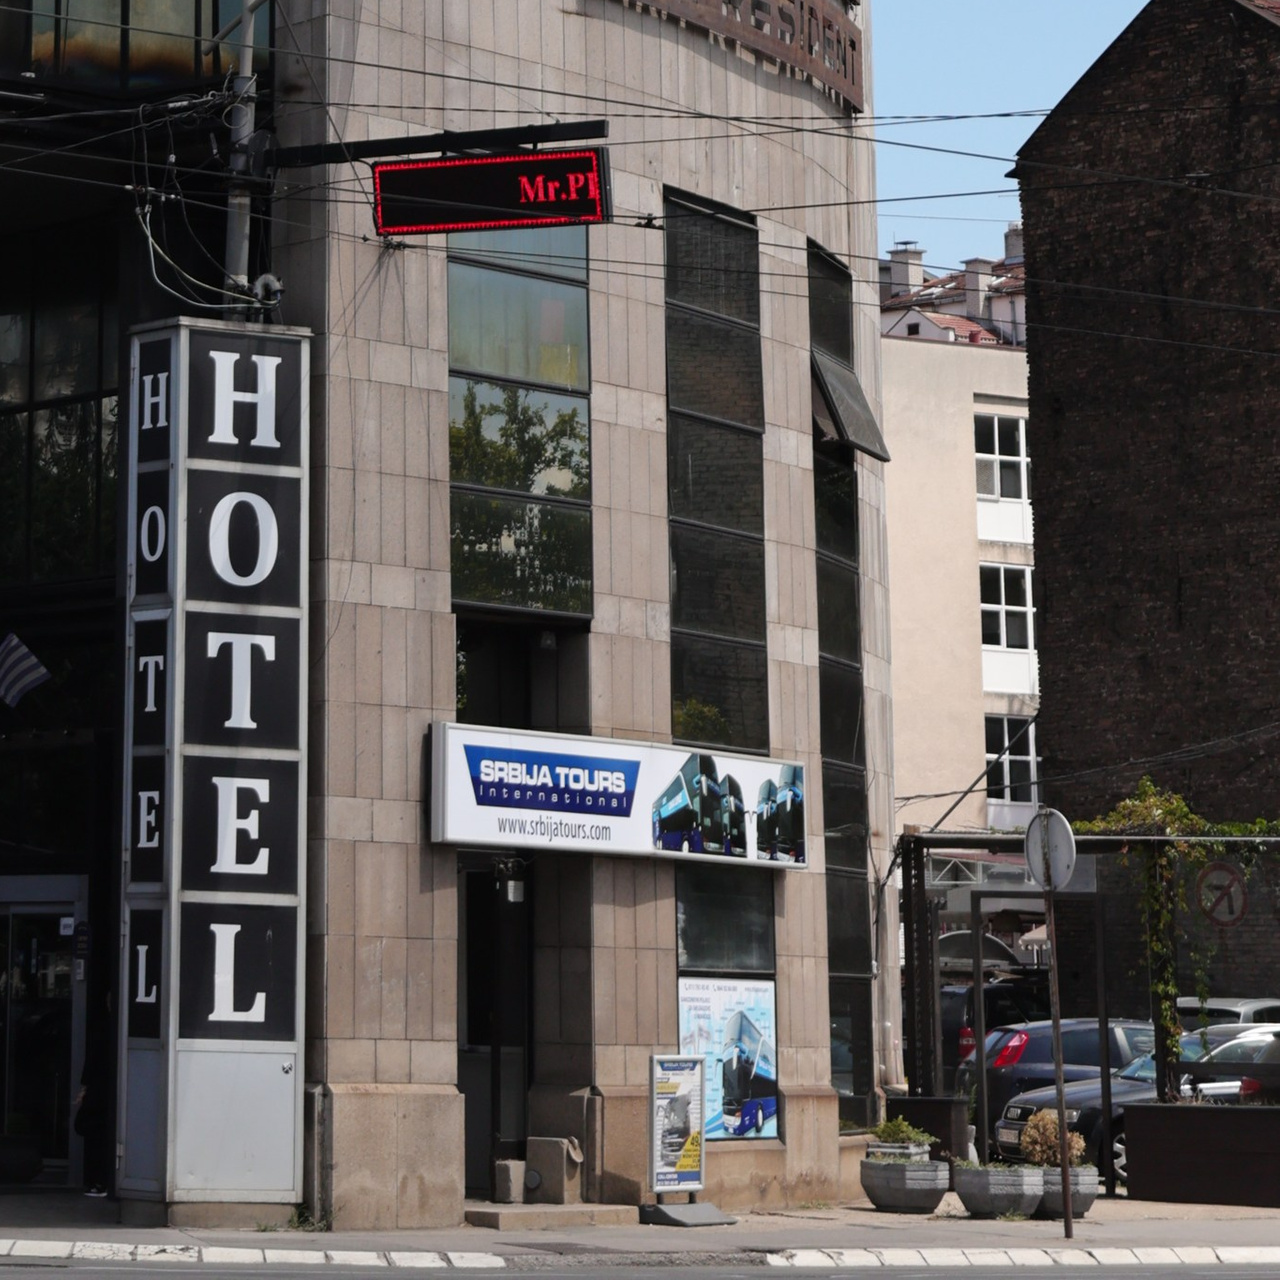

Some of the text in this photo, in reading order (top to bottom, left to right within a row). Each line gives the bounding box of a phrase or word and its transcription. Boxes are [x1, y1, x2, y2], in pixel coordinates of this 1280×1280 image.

[135, 371, 170, 1005] HOTEL
[206, 349, 283, 1024] HOTEL
[479, 759, 626, 794] SRBIJA TOURS
[479, 784, 627, 808] International
[497, 815, 612, 842] www.srbijatours.com
